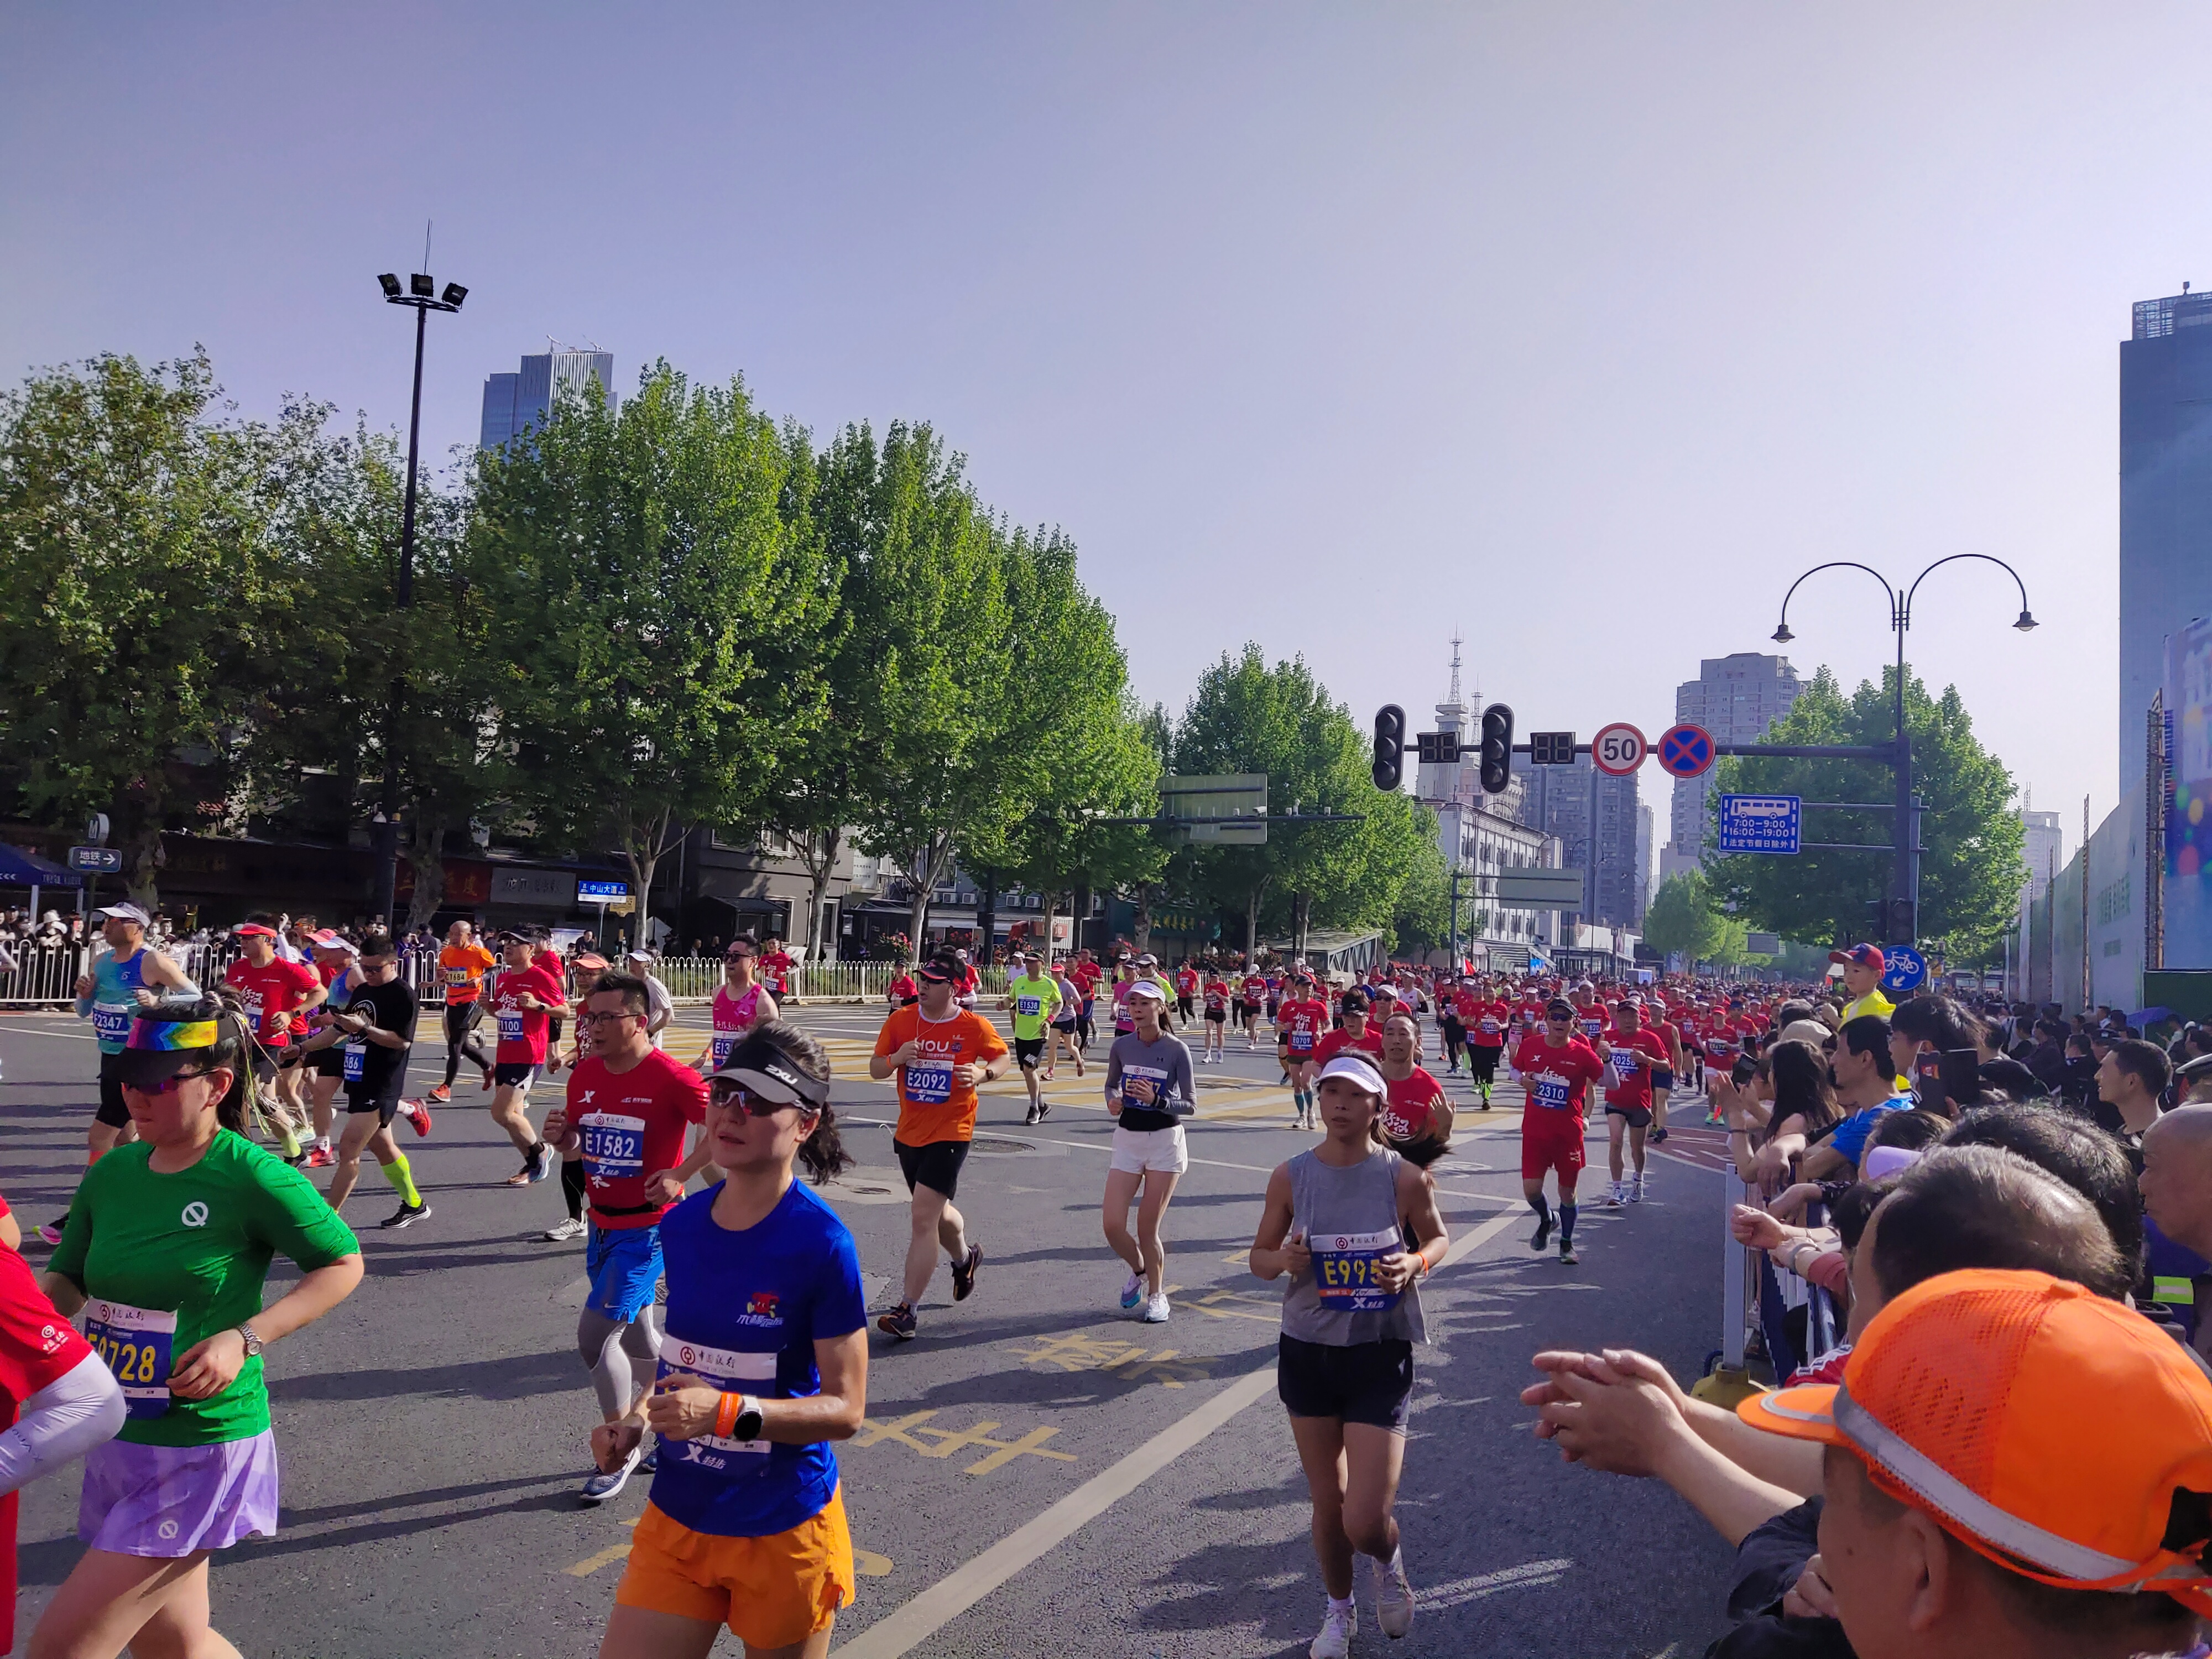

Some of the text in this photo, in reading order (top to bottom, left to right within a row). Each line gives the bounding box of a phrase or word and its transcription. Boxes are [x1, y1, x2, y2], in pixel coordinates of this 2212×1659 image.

[1604, 738, 1636, 761] 50
[1729, 838, 1788, 849] 法定节假日除外
[79, 851, 101, 861] 地铁
[589, 884, 617, 894] 中山大道
[1020, 1001, 1037, 1009] E1538
[93, 1014, 122, 1029] F2347
[714, 1041, 730, 1055] E13
[907, 1071, 946, 1090] E2092
[1538, 1084, 1564, 1099] 2310
[585, 1133, 634, 1157] E1582
[1350, 1236, 1378, 1245] 中国银行
[1323, 1259, 1381, 1285] E995
[698, 1350, 736, 1369] 中国银行
[703, 1455, 727, 1469] 特步
